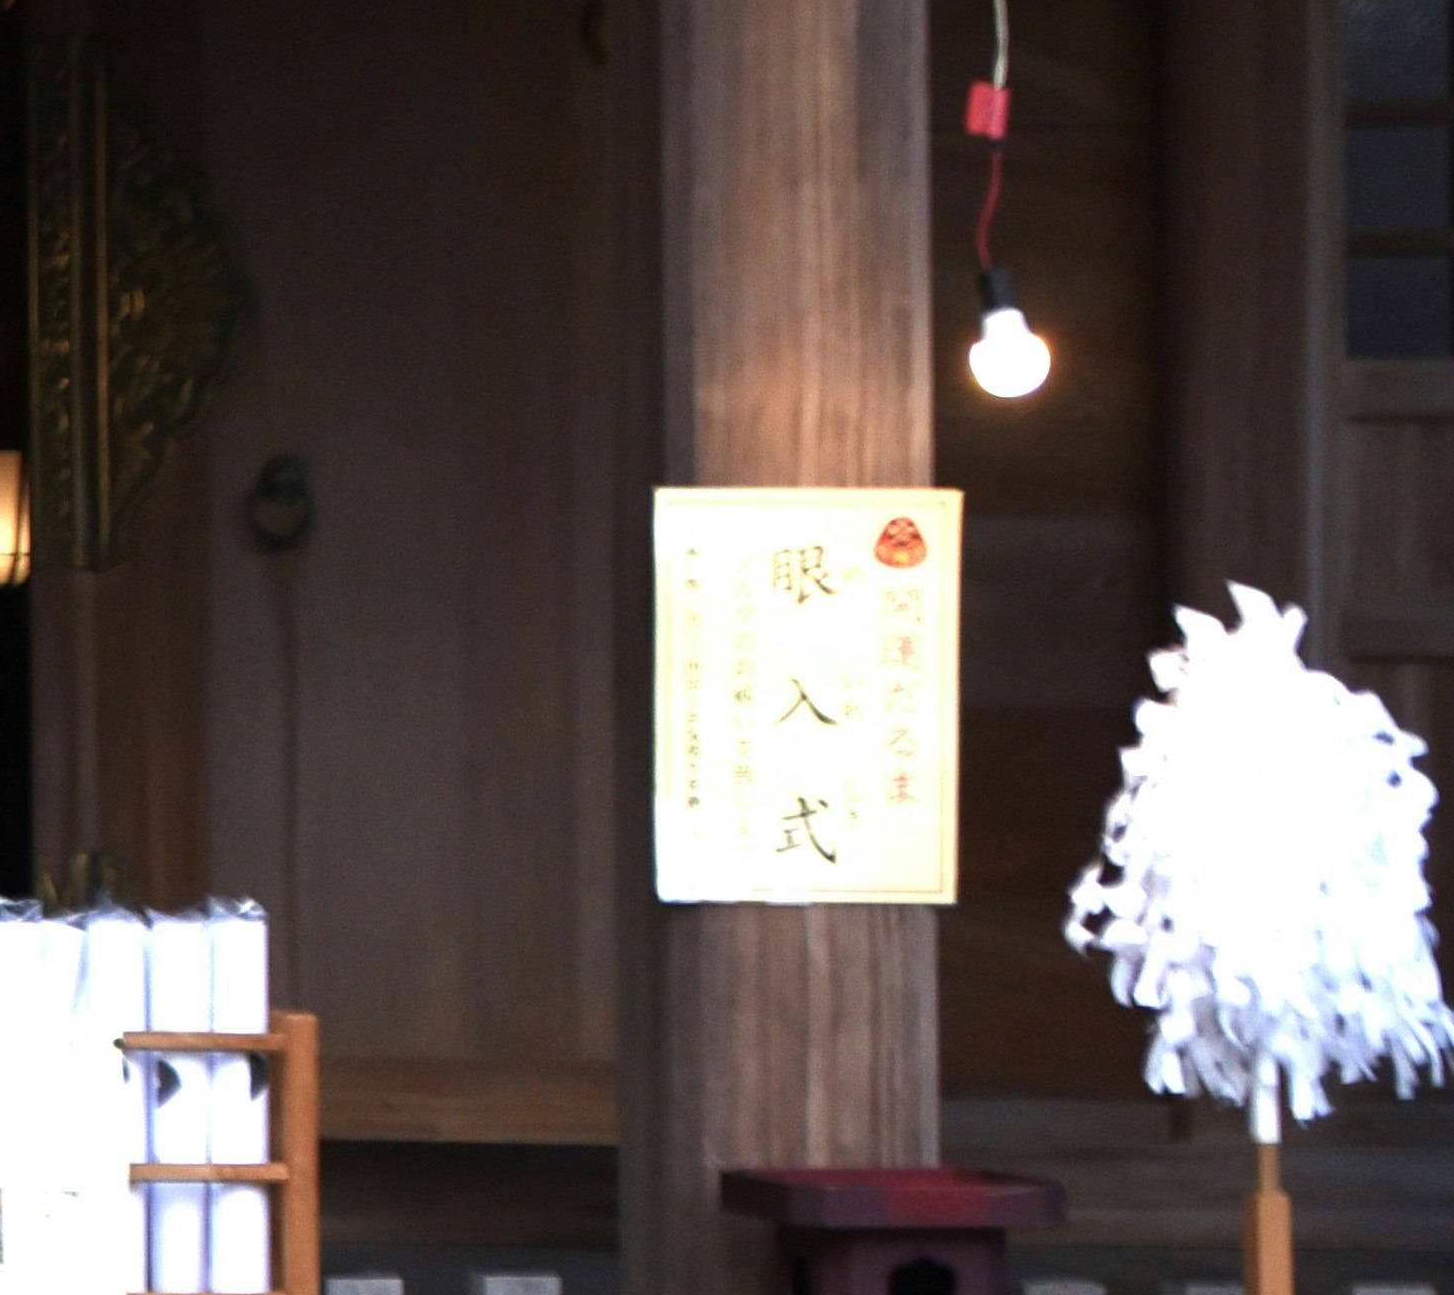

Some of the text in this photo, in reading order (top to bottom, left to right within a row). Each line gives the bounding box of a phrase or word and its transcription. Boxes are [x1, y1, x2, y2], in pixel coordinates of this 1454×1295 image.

[771, 545, 840, 864] 眼入式
[879, 589, 924, 804] 開運だるま
